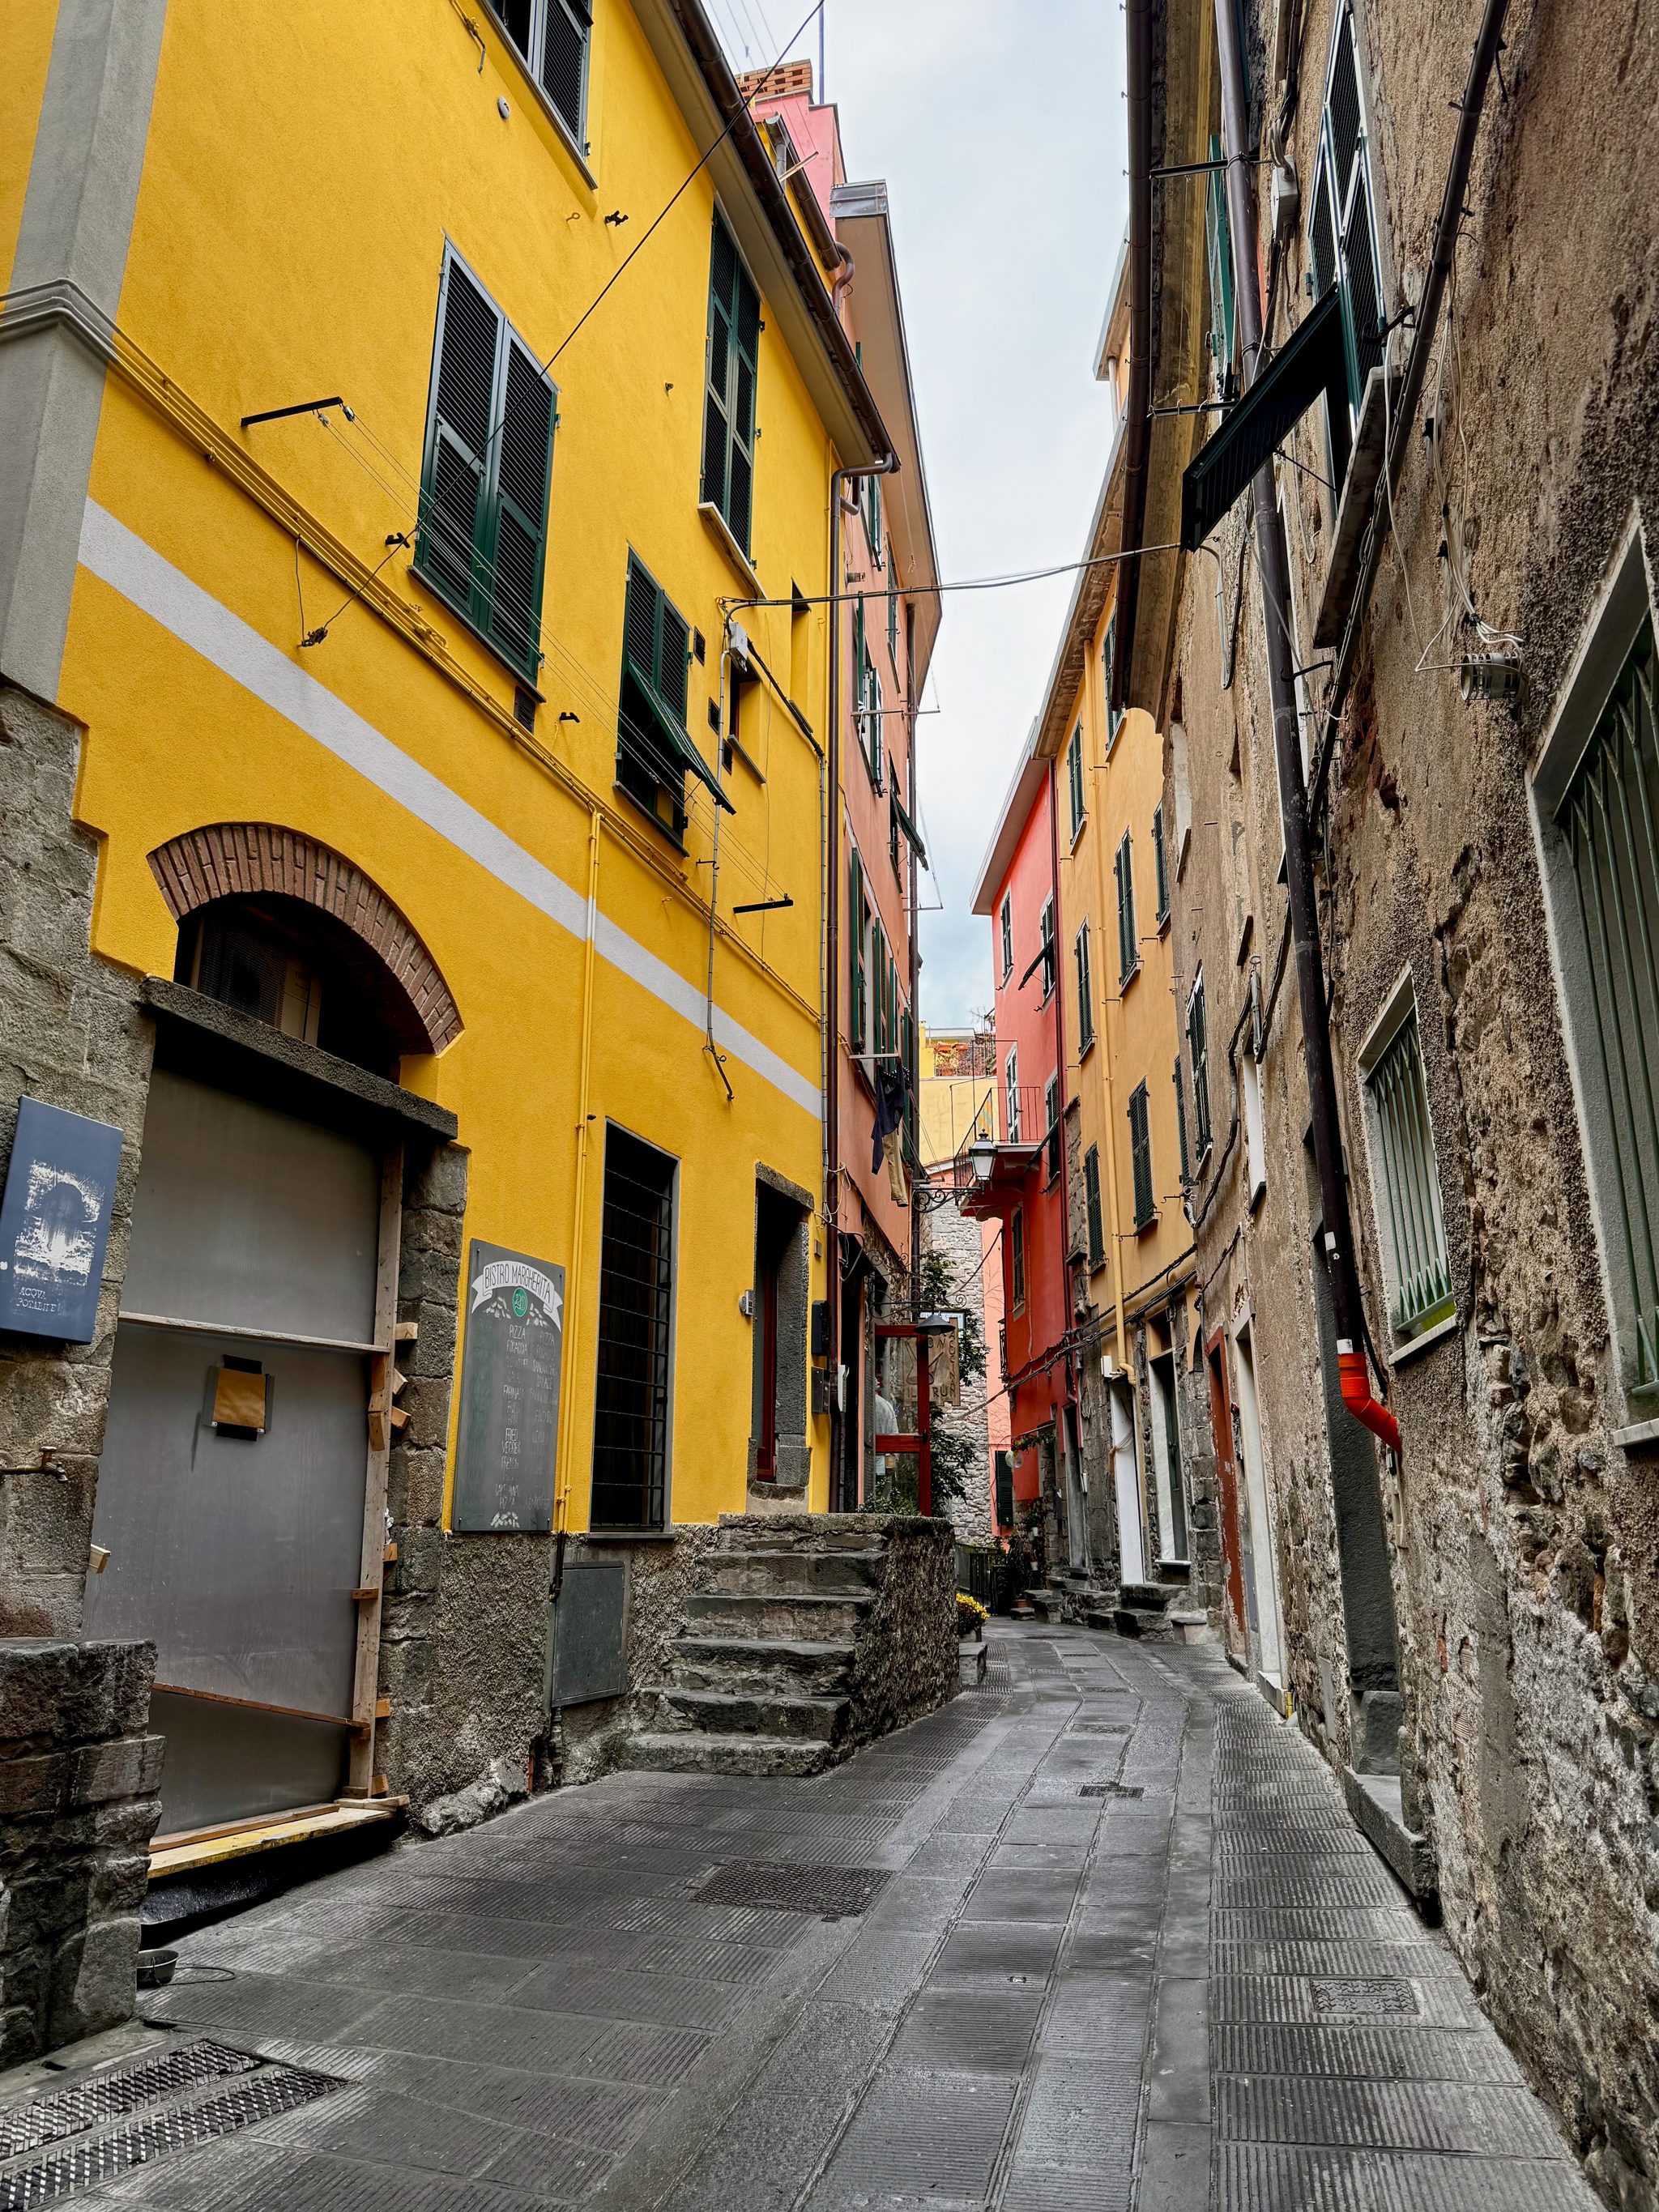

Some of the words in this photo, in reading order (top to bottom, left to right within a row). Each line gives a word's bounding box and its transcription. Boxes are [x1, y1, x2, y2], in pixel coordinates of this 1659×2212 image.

[484, 1264, 510, 1289] BISTRO
[511, 1264, 551, 1304] MARGHERITA
[509, 1324, 526, 1340] PIZZA
